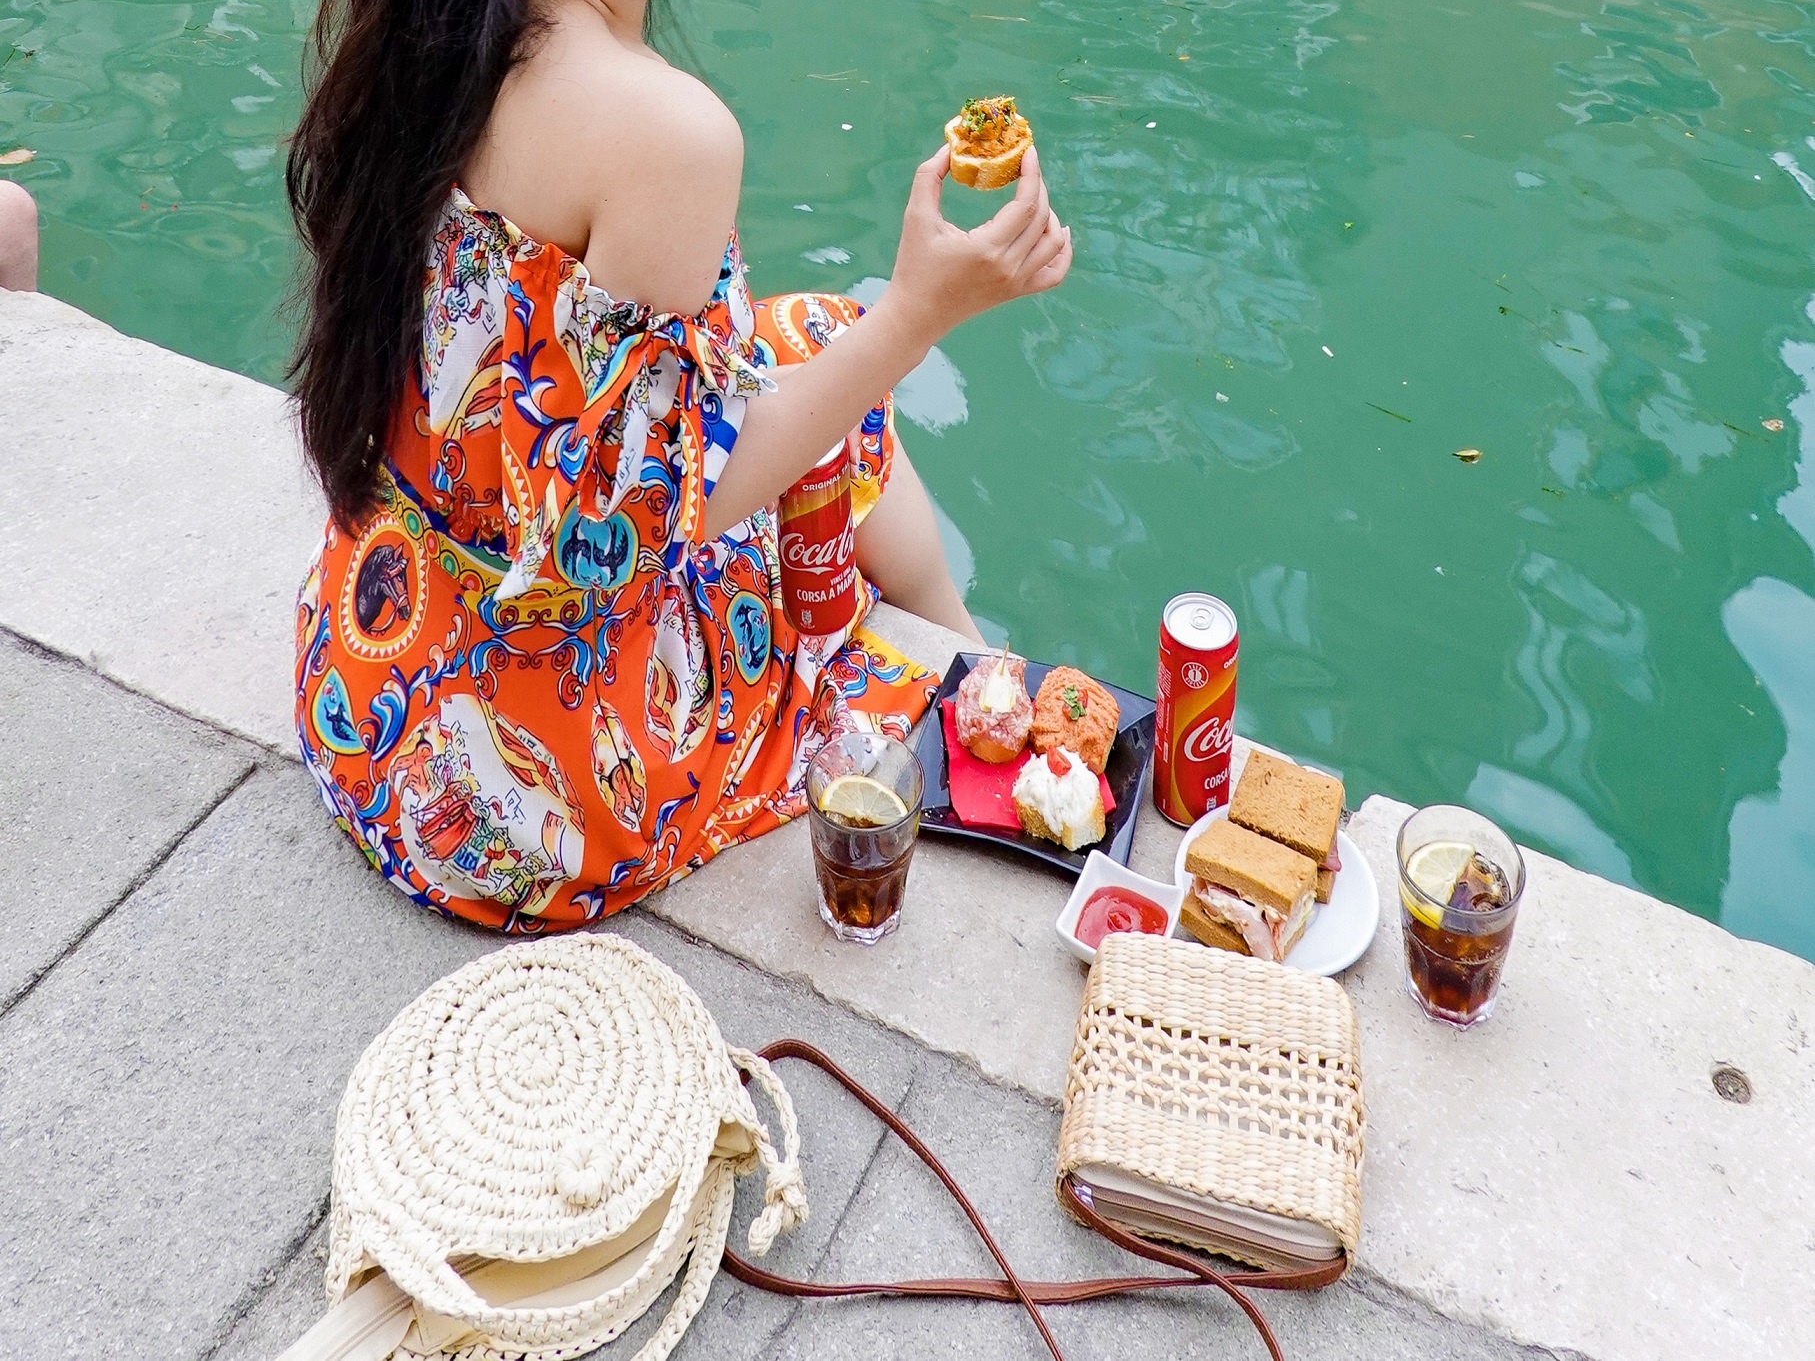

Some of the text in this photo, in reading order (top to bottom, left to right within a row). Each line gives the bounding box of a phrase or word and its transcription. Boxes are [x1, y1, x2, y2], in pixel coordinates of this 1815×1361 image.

[802, 473, 841, 492] ORIGINAL
[796, 588, 828, 603] CORSA
[829, 587, 836, 600] A
